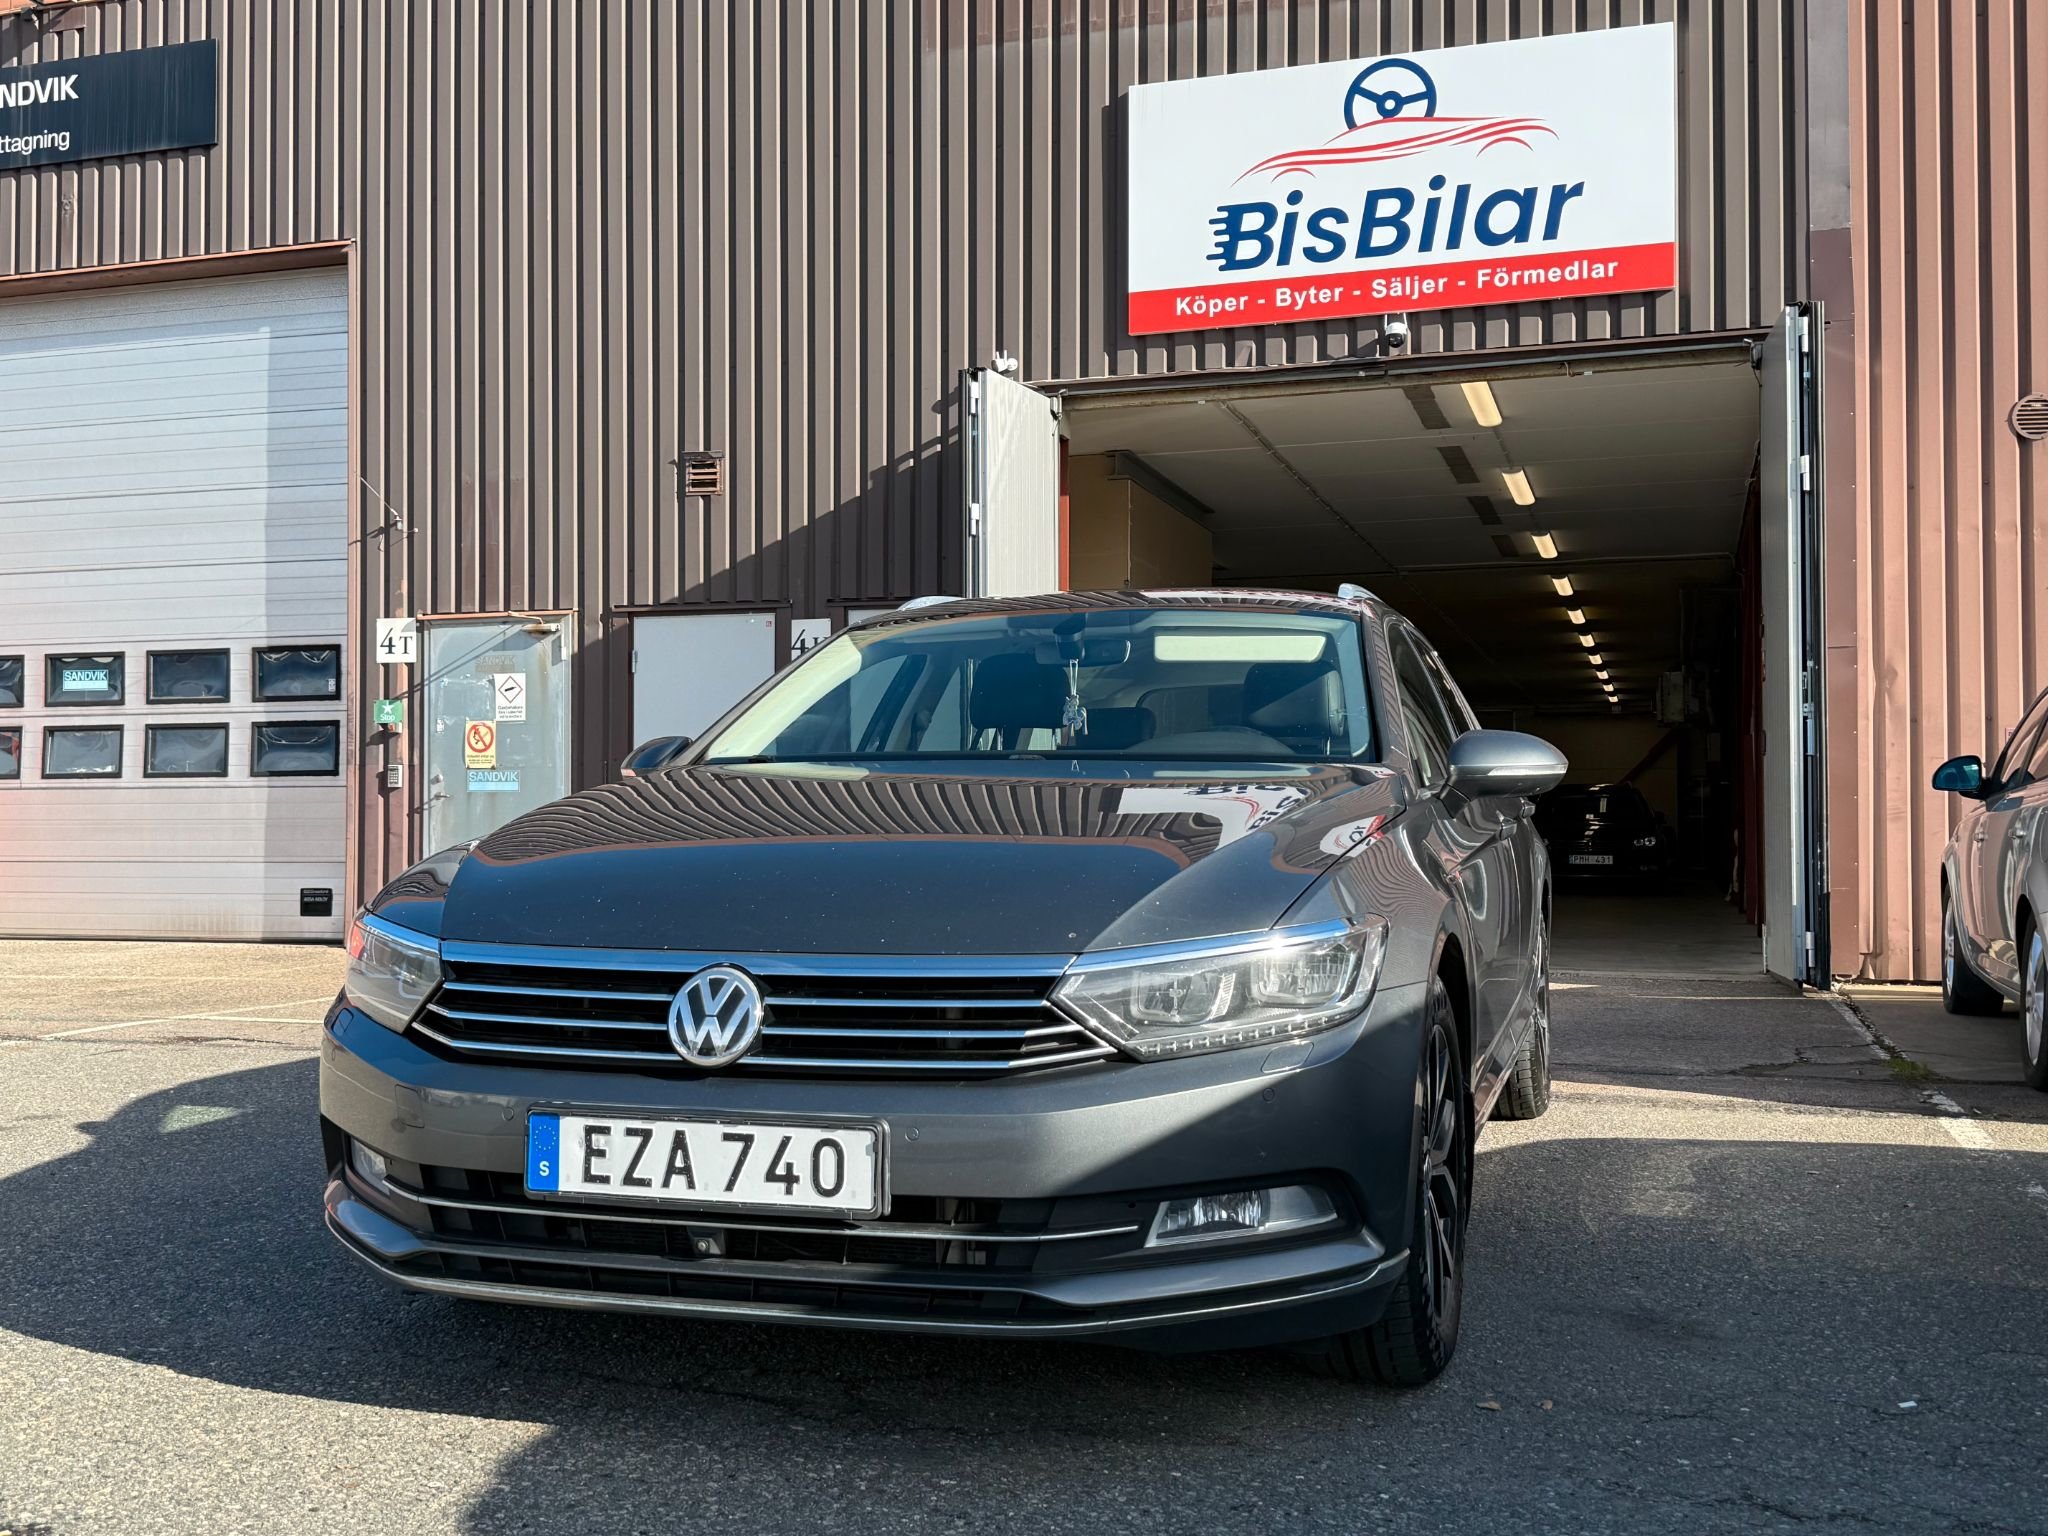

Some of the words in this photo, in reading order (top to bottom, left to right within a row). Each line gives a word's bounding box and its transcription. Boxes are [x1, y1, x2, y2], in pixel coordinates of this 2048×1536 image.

[0, 74, 79, 109] NDVIK
[1206, 174, 1585, 273] BisBilar
[1175, 294, 1249, 318] Köper
[1275, 286, 1344, 311] Byter
[1371, 275, 1449, 300] Säljer
[1477, 258, 1619, 289] Förmedlar
[380, 627, 413, 655] 4T
[64, 671, 107, 681] SANDVIK
[380, 713, 396, 722] Stop
[469, 771, 518, 782] SANDVIK
[538, 1160, 550, 1177] S
[582, 1123, 697, 1193] EZA
[721, 1131, 846, 1198] 740
